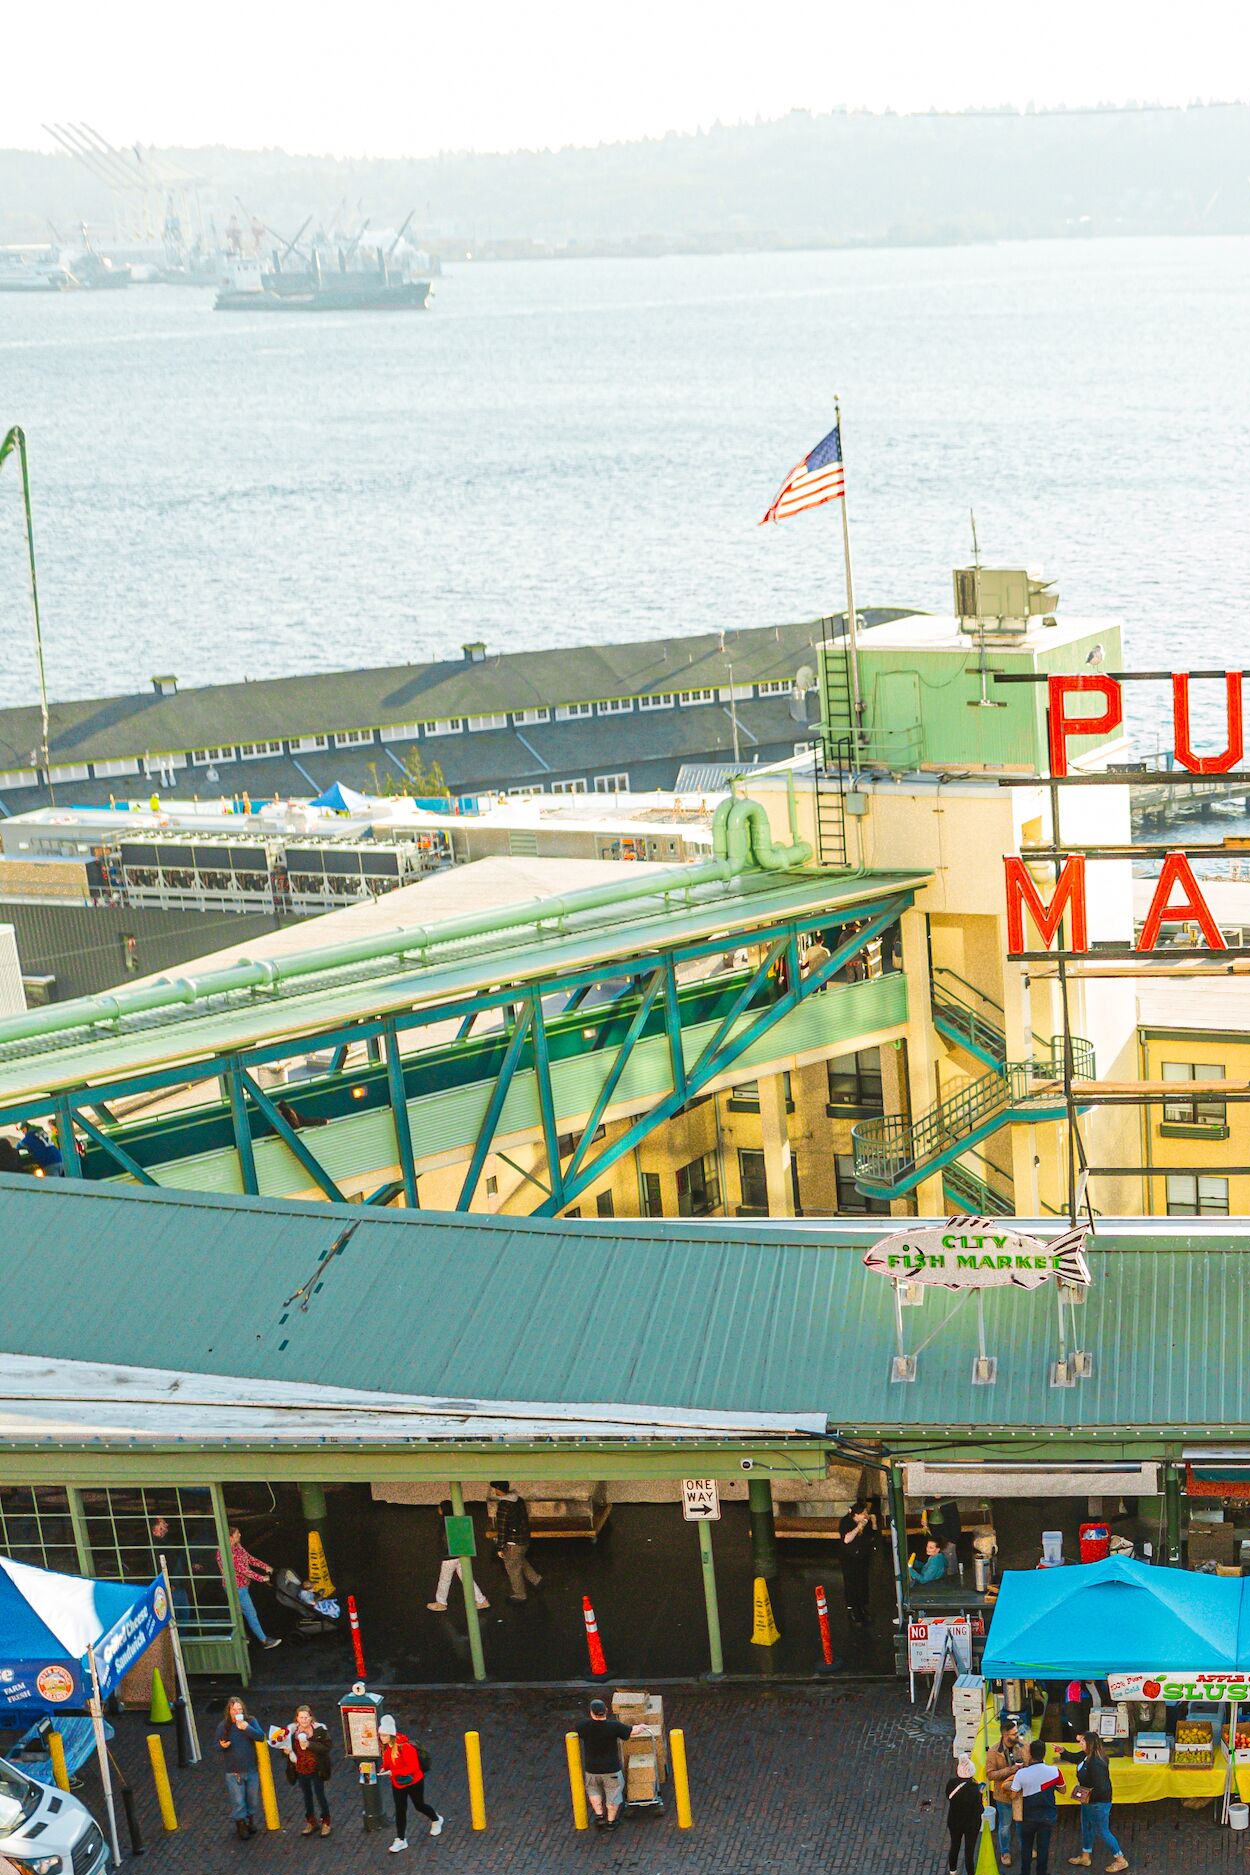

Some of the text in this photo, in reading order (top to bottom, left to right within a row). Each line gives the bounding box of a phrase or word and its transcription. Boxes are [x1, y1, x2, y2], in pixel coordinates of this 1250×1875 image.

[942, 1235, 1008, 1249] CITY
[887, 1255, 1063, 1270] FISH MARKET
[687, 1480, 712, 1490] ONE
[687, 1492, 713, 1502] WAY
[911, 1626, 926, 1639] NO
[1196, 1674, 1244, 1683] APPLE
[4, 1682, 26, 1695] FARM
[7, 1690, 31, 1703] FRESH
